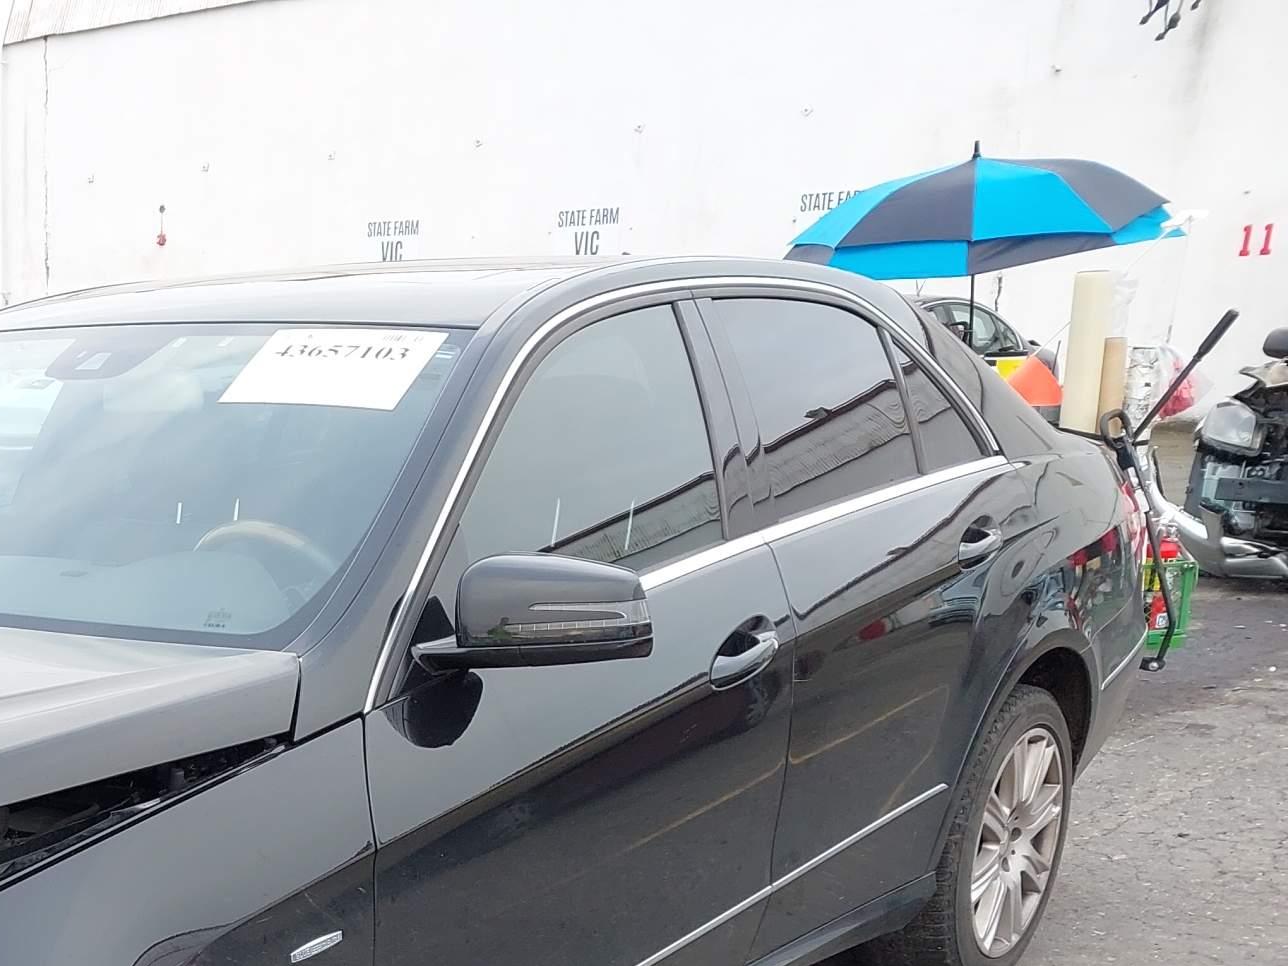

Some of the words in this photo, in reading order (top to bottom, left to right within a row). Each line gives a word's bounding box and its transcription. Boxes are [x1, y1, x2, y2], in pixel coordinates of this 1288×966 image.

[800, 191, 834, 212] STATE
[557, 208, 587, 228] STATE
[589, 207, 620, 226] FARM
[367, 221, 392, 238] STATE
[393, 219, 420, 237] FARM
[574, 230, 600, 256] VIC
[1239, 223, 1274, 257] 11
[381, 241, 404, 262] VIC
[275, 344, 411, 361] 43657103
